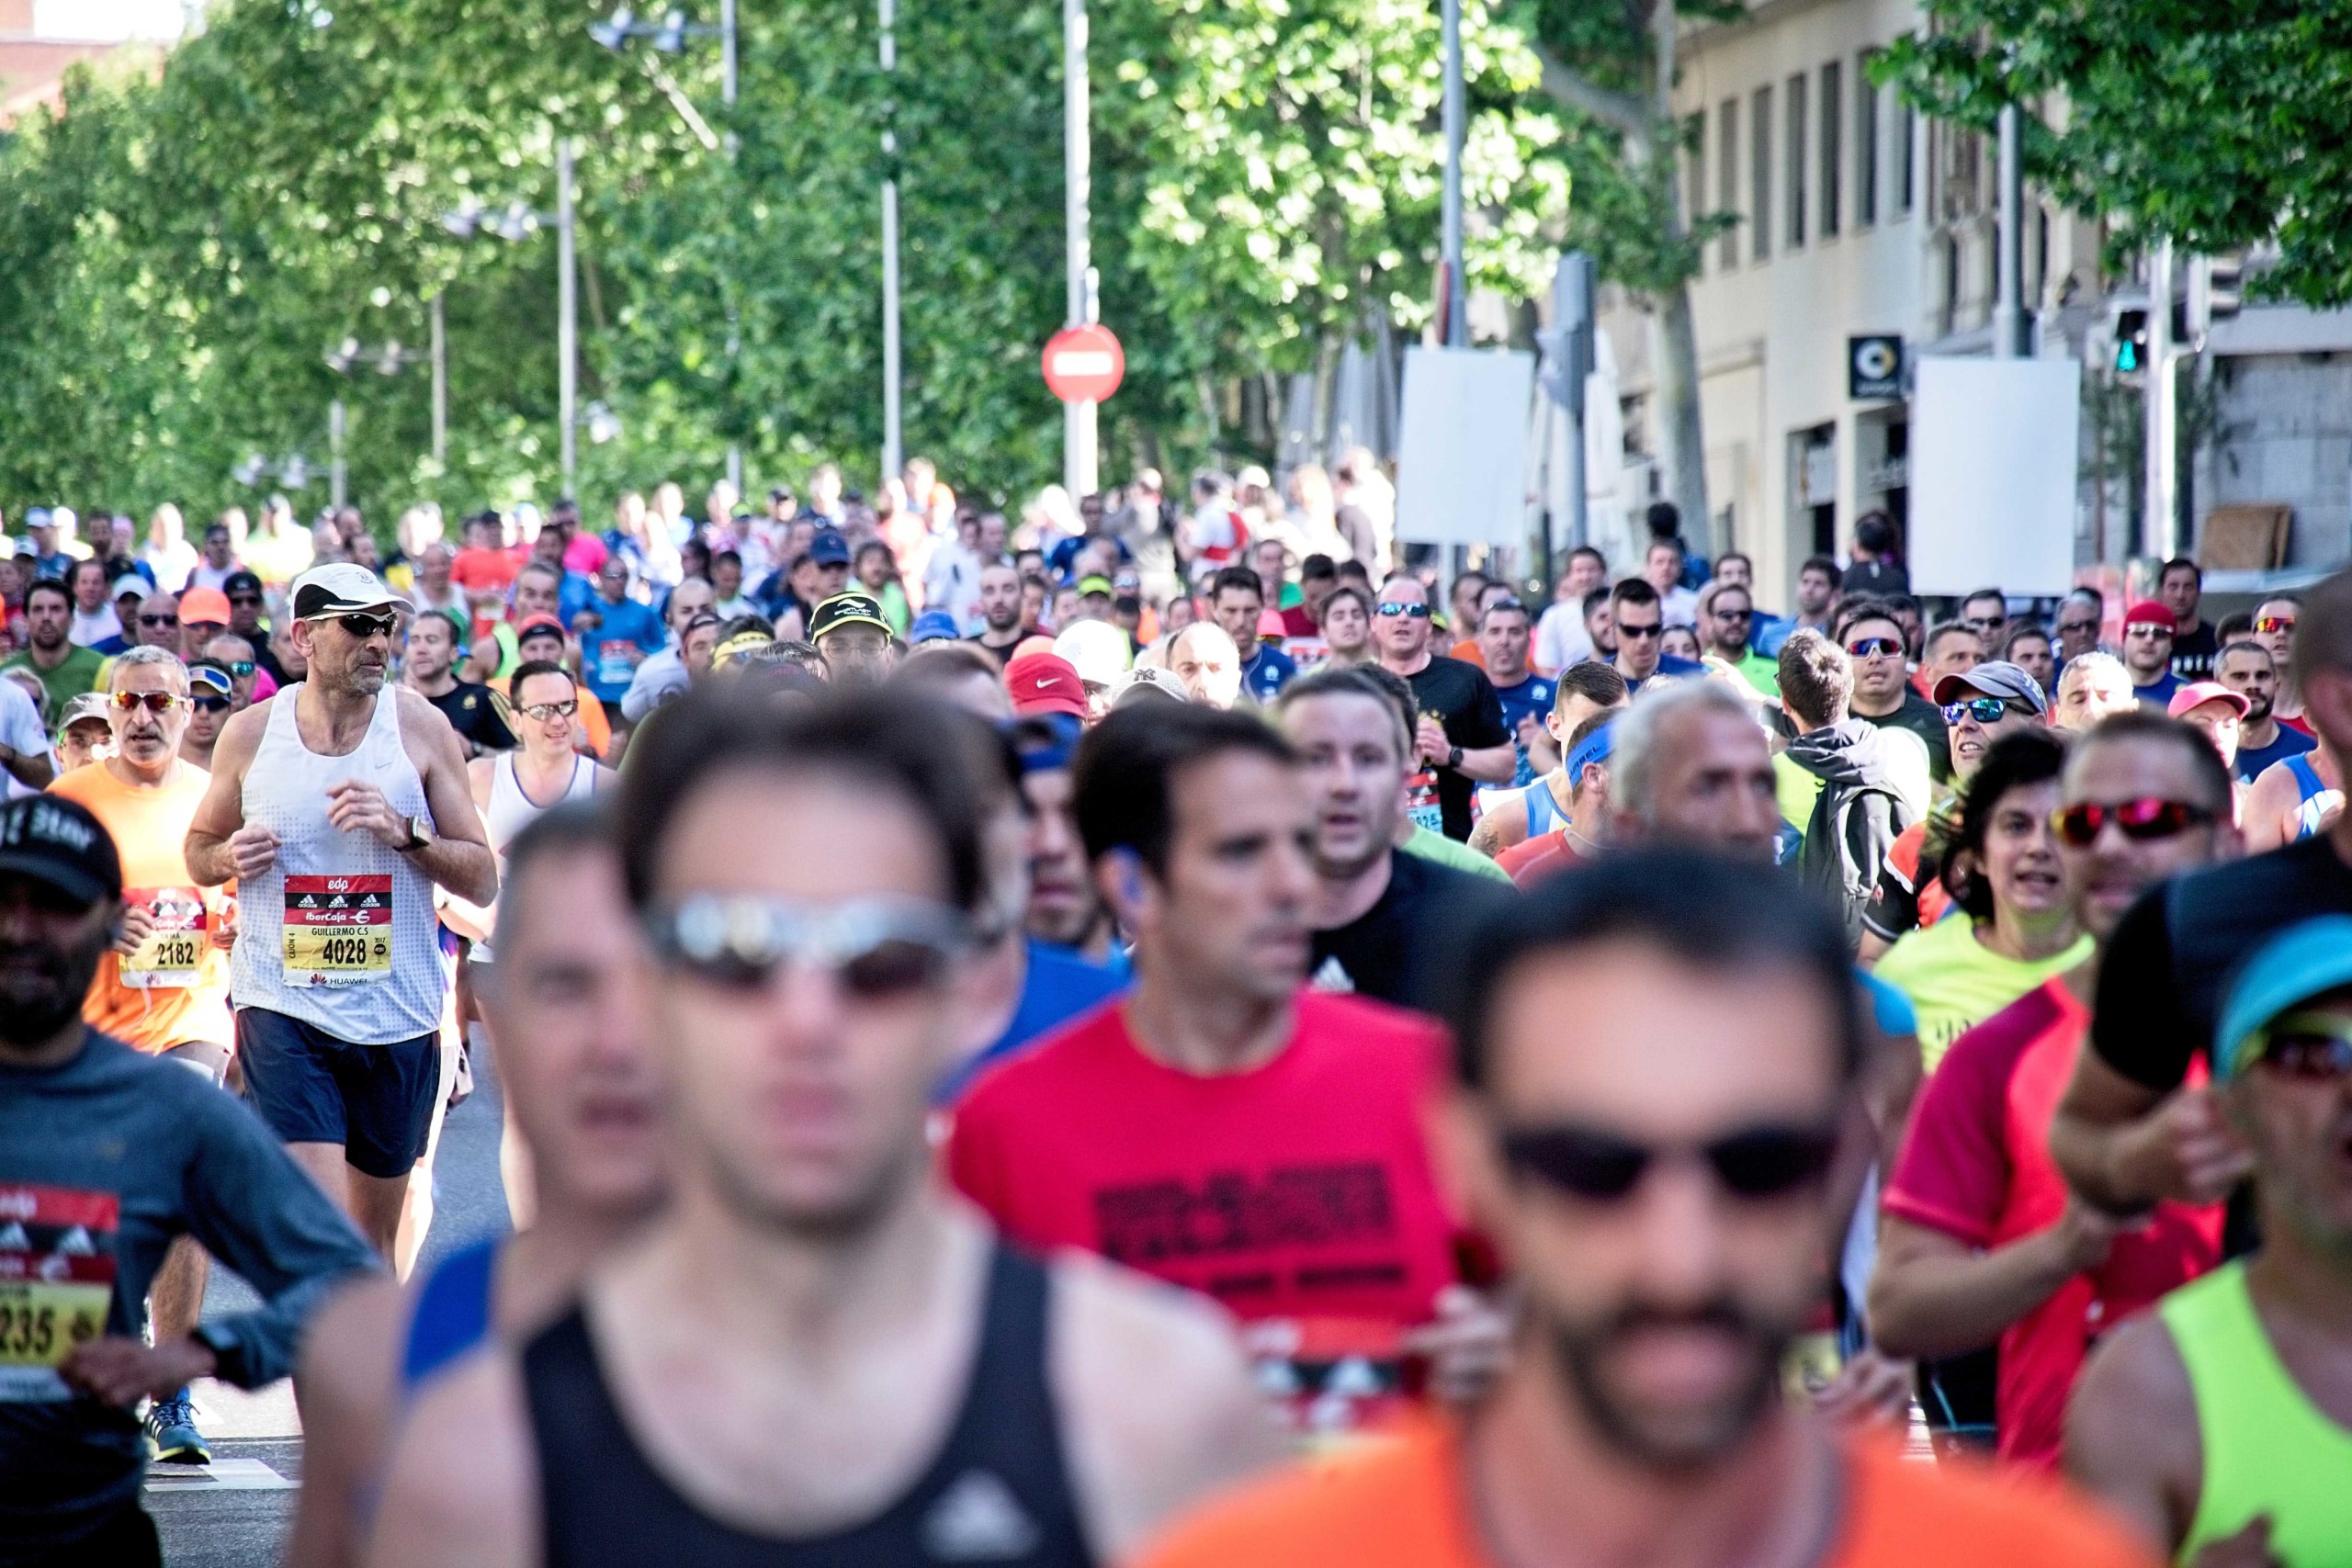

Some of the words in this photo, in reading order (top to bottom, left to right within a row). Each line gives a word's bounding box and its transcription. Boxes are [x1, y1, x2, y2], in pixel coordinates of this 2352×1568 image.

[328, 877, 349, 892] edp
[311, 927, 355, 936] GUILLERMO
[157, 942, 194, 965] 2182
[322, 939, 367, 964] 4028
[0, 1304, 55, 1354] 235
